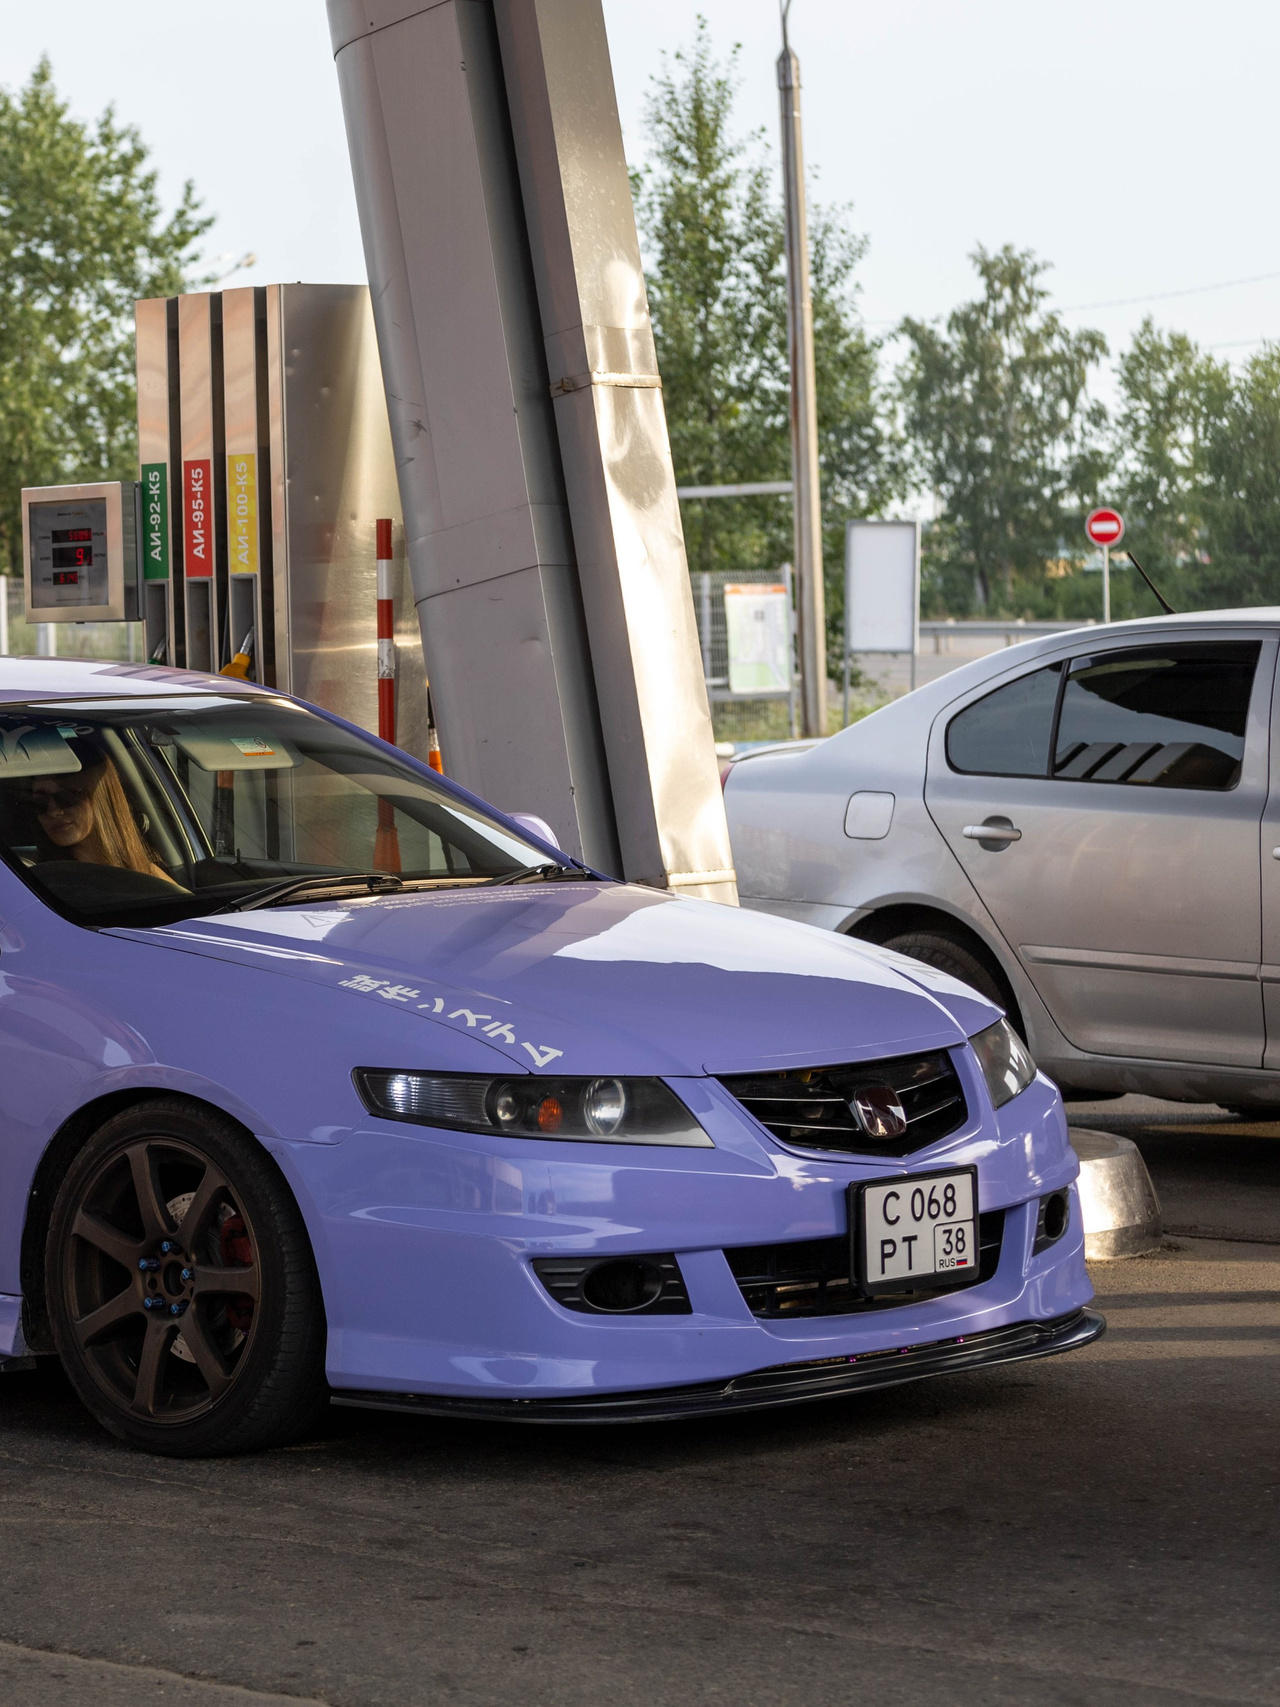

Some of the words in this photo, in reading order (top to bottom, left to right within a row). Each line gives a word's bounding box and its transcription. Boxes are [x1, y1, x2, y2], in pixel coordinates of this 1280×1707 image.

[149, 471, 162, 561] АИ-92-К5
[191, 468, 205, 559] АИ-95-К5
[236, 462, 249, 565] АИ-100-К5
[910, 1183, 957, 1222] 068
[939, 1257, 956, 1269] RUS
[942, 1227, 966, 1255] 38
